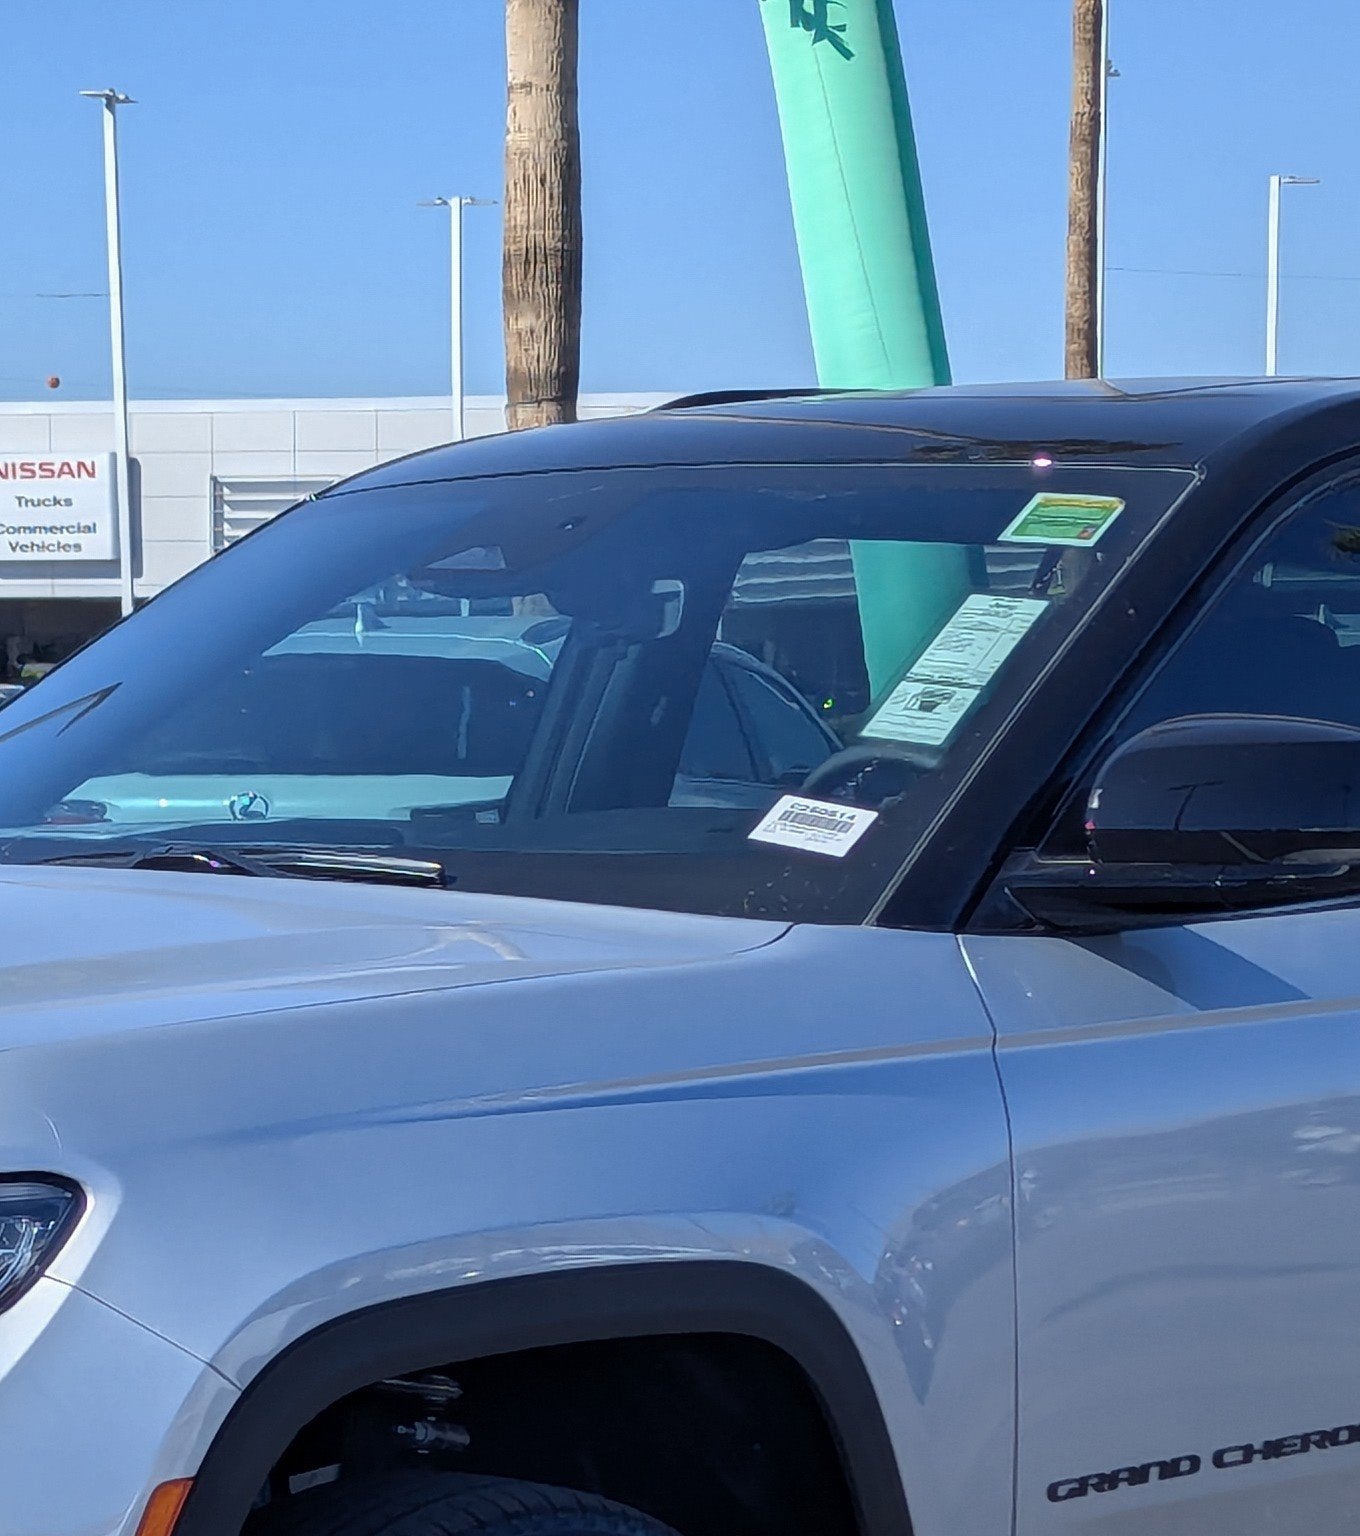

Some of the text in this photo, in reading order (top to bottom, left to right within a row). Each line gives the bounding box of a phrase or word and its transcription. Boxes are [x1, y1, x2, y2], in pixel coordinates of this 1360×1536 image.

[15, 495, 74, 508] Trucks
[8, 540, 82, 553] Vehicles
[1046, 1453, 1201, 1502] GRAND
